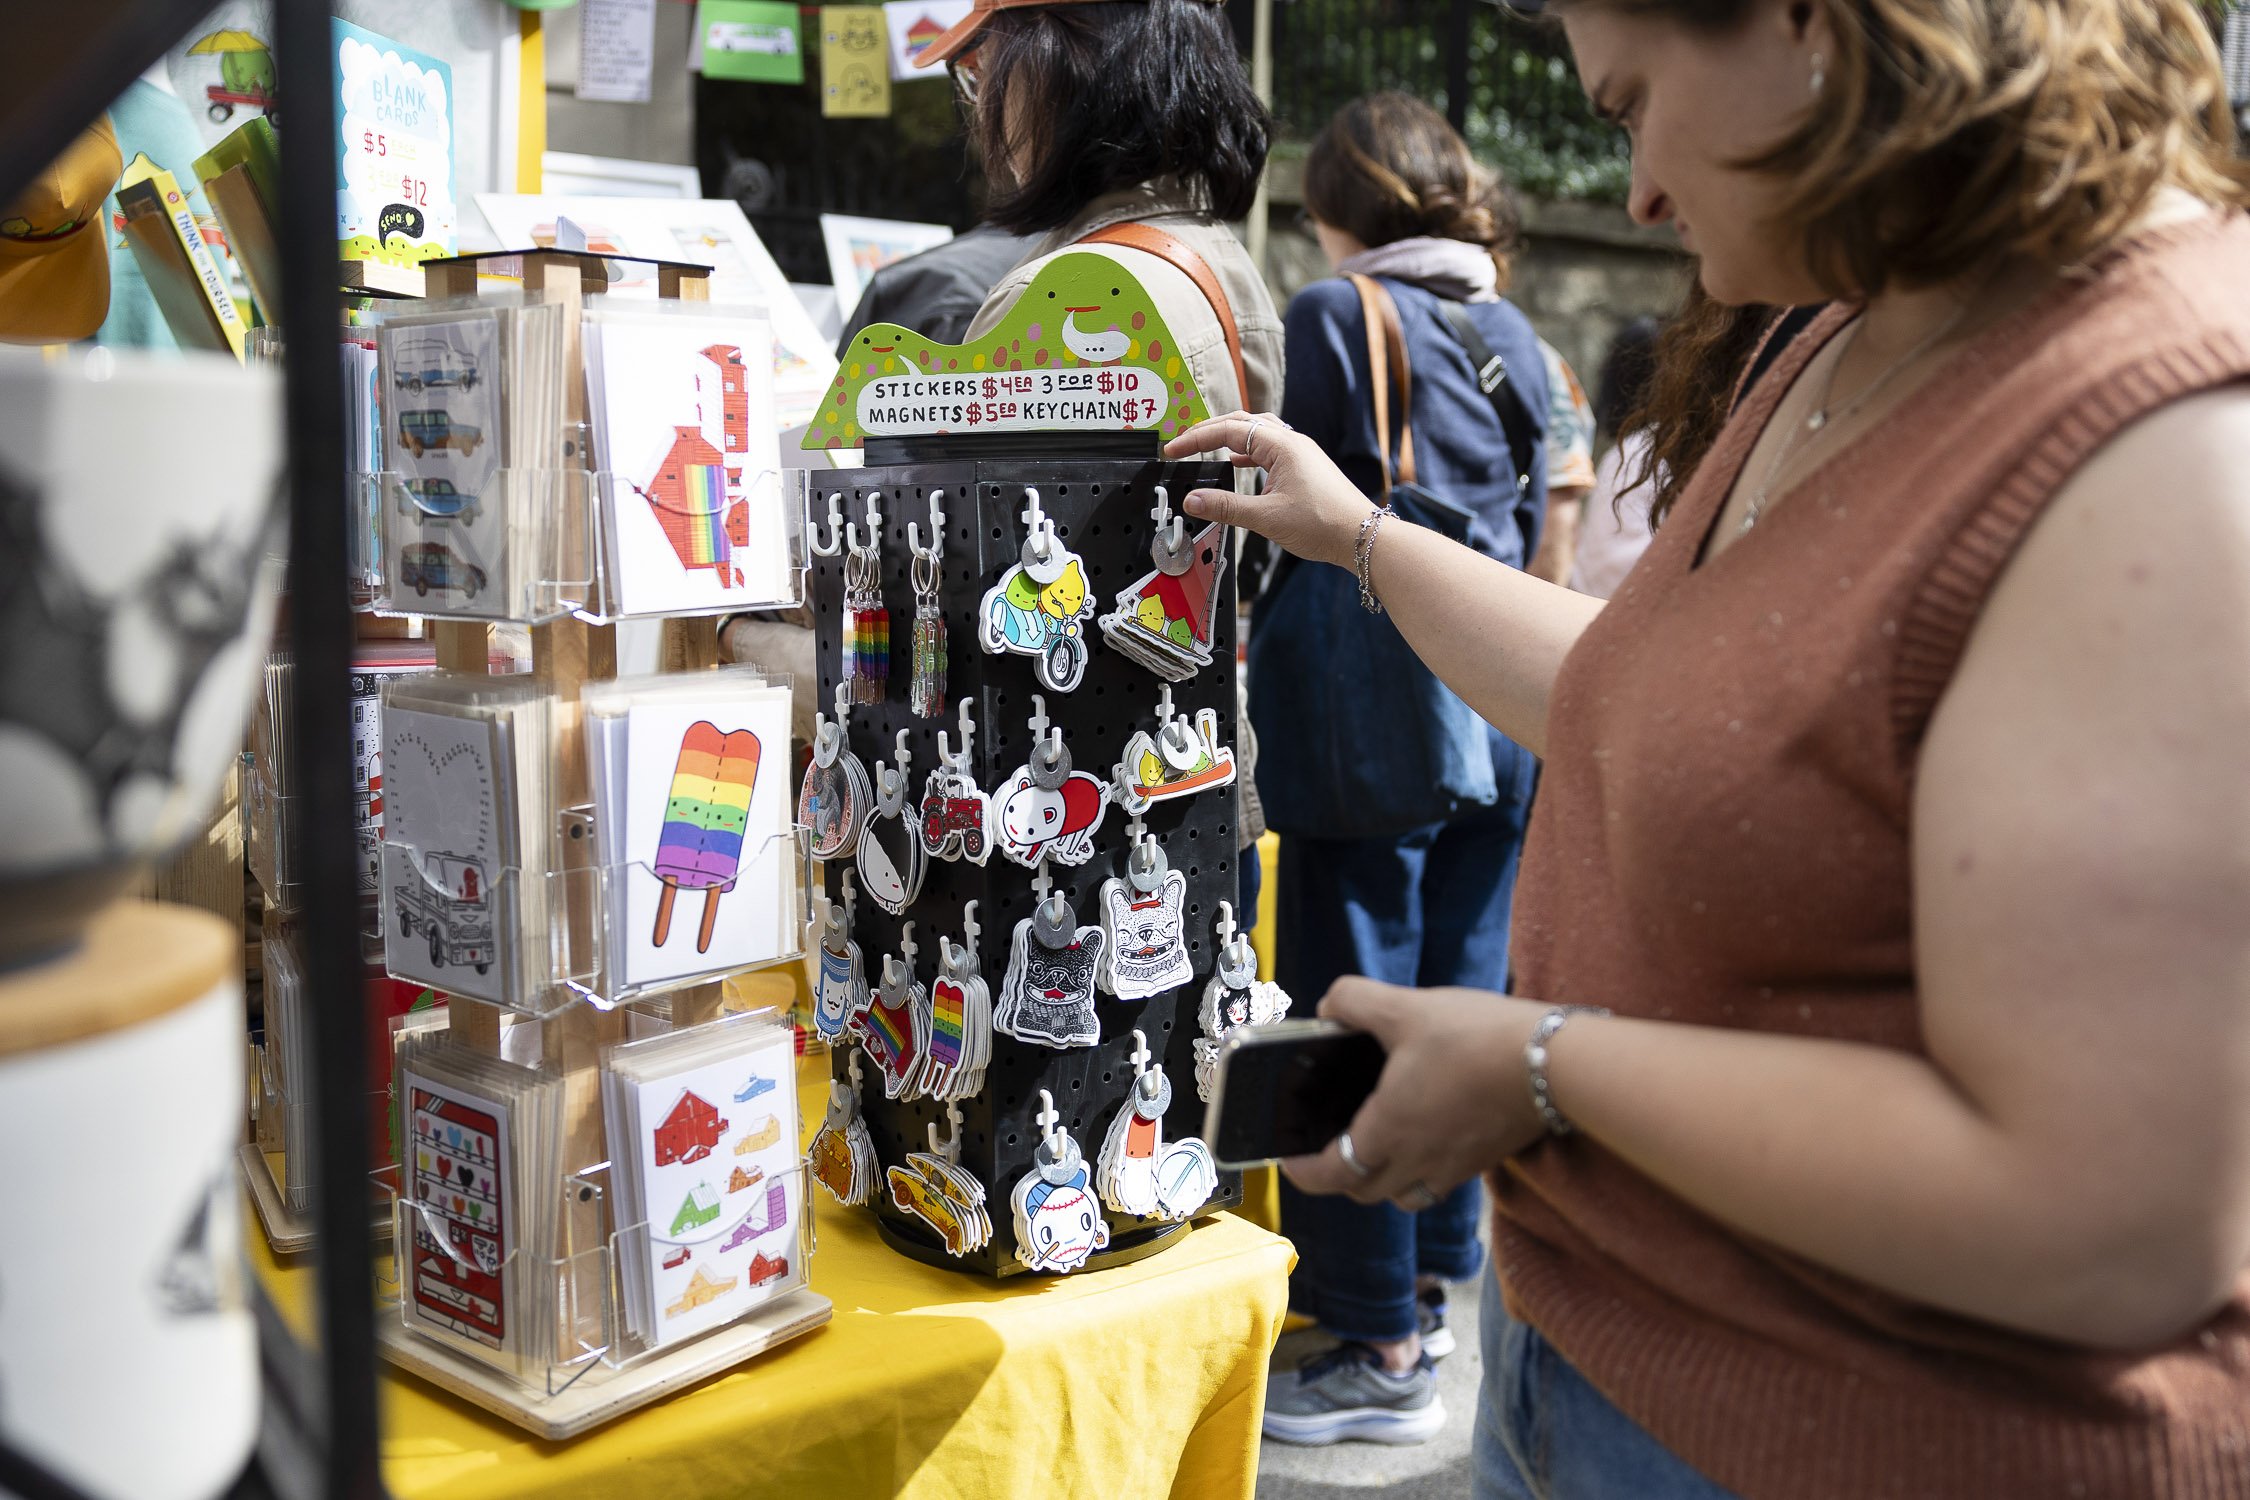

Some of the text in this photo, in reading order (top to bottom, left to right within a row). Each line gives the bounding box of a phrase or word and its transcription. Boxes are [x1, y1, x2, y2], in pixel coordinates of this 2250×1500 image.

[373, 73, 426, 112] BLANK
[376, 104, 418, 127] CARDS
[402, 175, 427, 207] $12
[380, 213, 402, 231] SEND
[177, 213, 202, 252] THINK
[203, 268, 235, 320] YOURSELF
[875, 380, 977, 398] STICKERS
[1041, 375, 1053, 394] 3
[1058, 373, 1093, 388] FOR
[1096, 371, 1139, 394] $10
[869, 404, 963, 424] MAGNETS
[1023, 400, 1121, 420] KEYCHAIN
